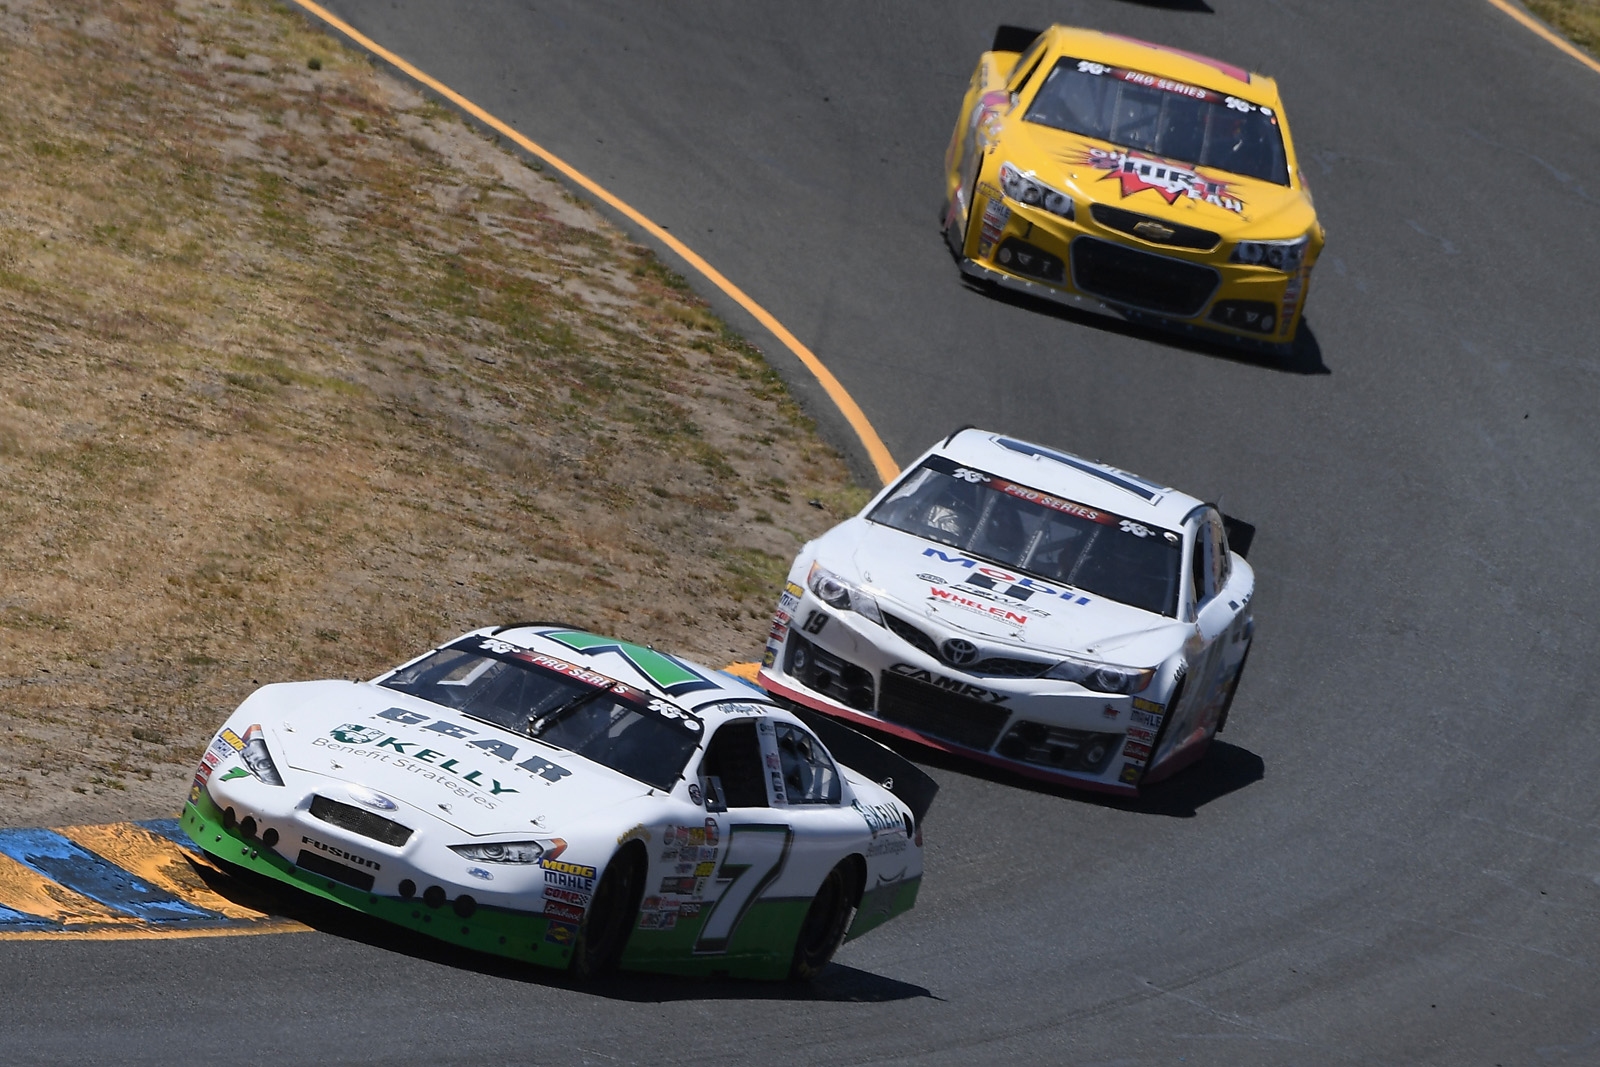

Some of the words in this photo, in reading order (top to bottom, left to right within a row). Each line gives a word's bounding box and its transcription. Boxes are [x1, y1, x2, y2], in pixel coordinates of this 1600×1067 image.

[1125, 72, 1154, 85] PRO
[1158, 79, 1207, 98] SERIES
[1005, 485, 1038, 500] PRO
[1041, 497, 1098, 520] SERIES
[922, 548, 1091, 606] Mobil
[802, 610, 829, 635] 19
[931, 587, 1027, 624] WHELEN
[479, 639, 520, 654] K&N
[532, 656, 568, 671] PRO
[569, 664, 629, 694] SERIS
[647, 699, 689, 720] K&N
[889, 663, 1010, 703] CAMRY
[376, 707, 573, 783] GEAR
[219, 766, 251, 782] 7
[312, 737, 387, 763] Benefit
[391, 758, 498, 810] Strategies
[376, 736, 520, 796] KELLY
[541, 859, 594, 877] MOOG
[545, 871, 593, 892] MAHLE
[692, 823, 793, 955] 7
